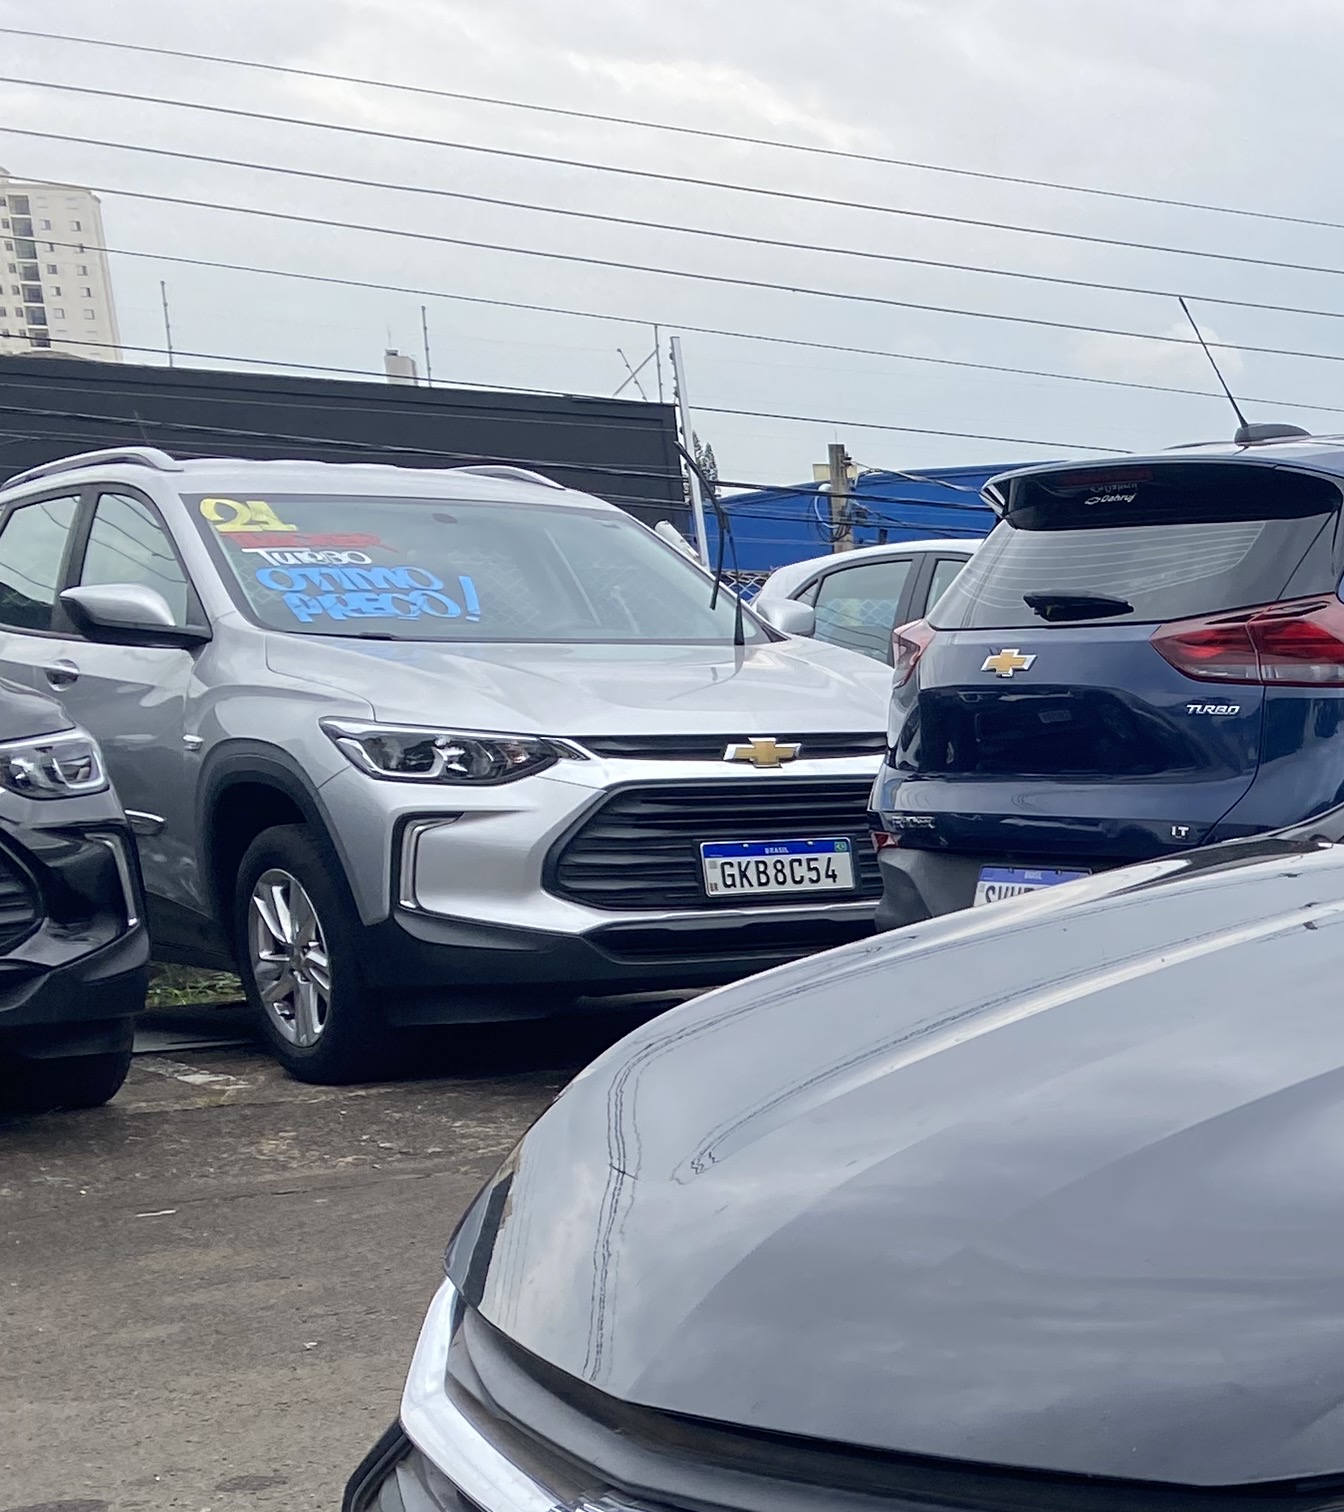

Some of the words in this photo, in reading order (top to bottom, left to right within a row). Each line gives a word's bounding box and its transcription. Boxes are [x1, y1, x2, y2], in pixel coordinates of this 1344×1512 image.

[1186, 704, 1241, 715] TURBO
[1171, 826, 1190, 837] LT
[720, 862, 838, 889] GKB8C54
